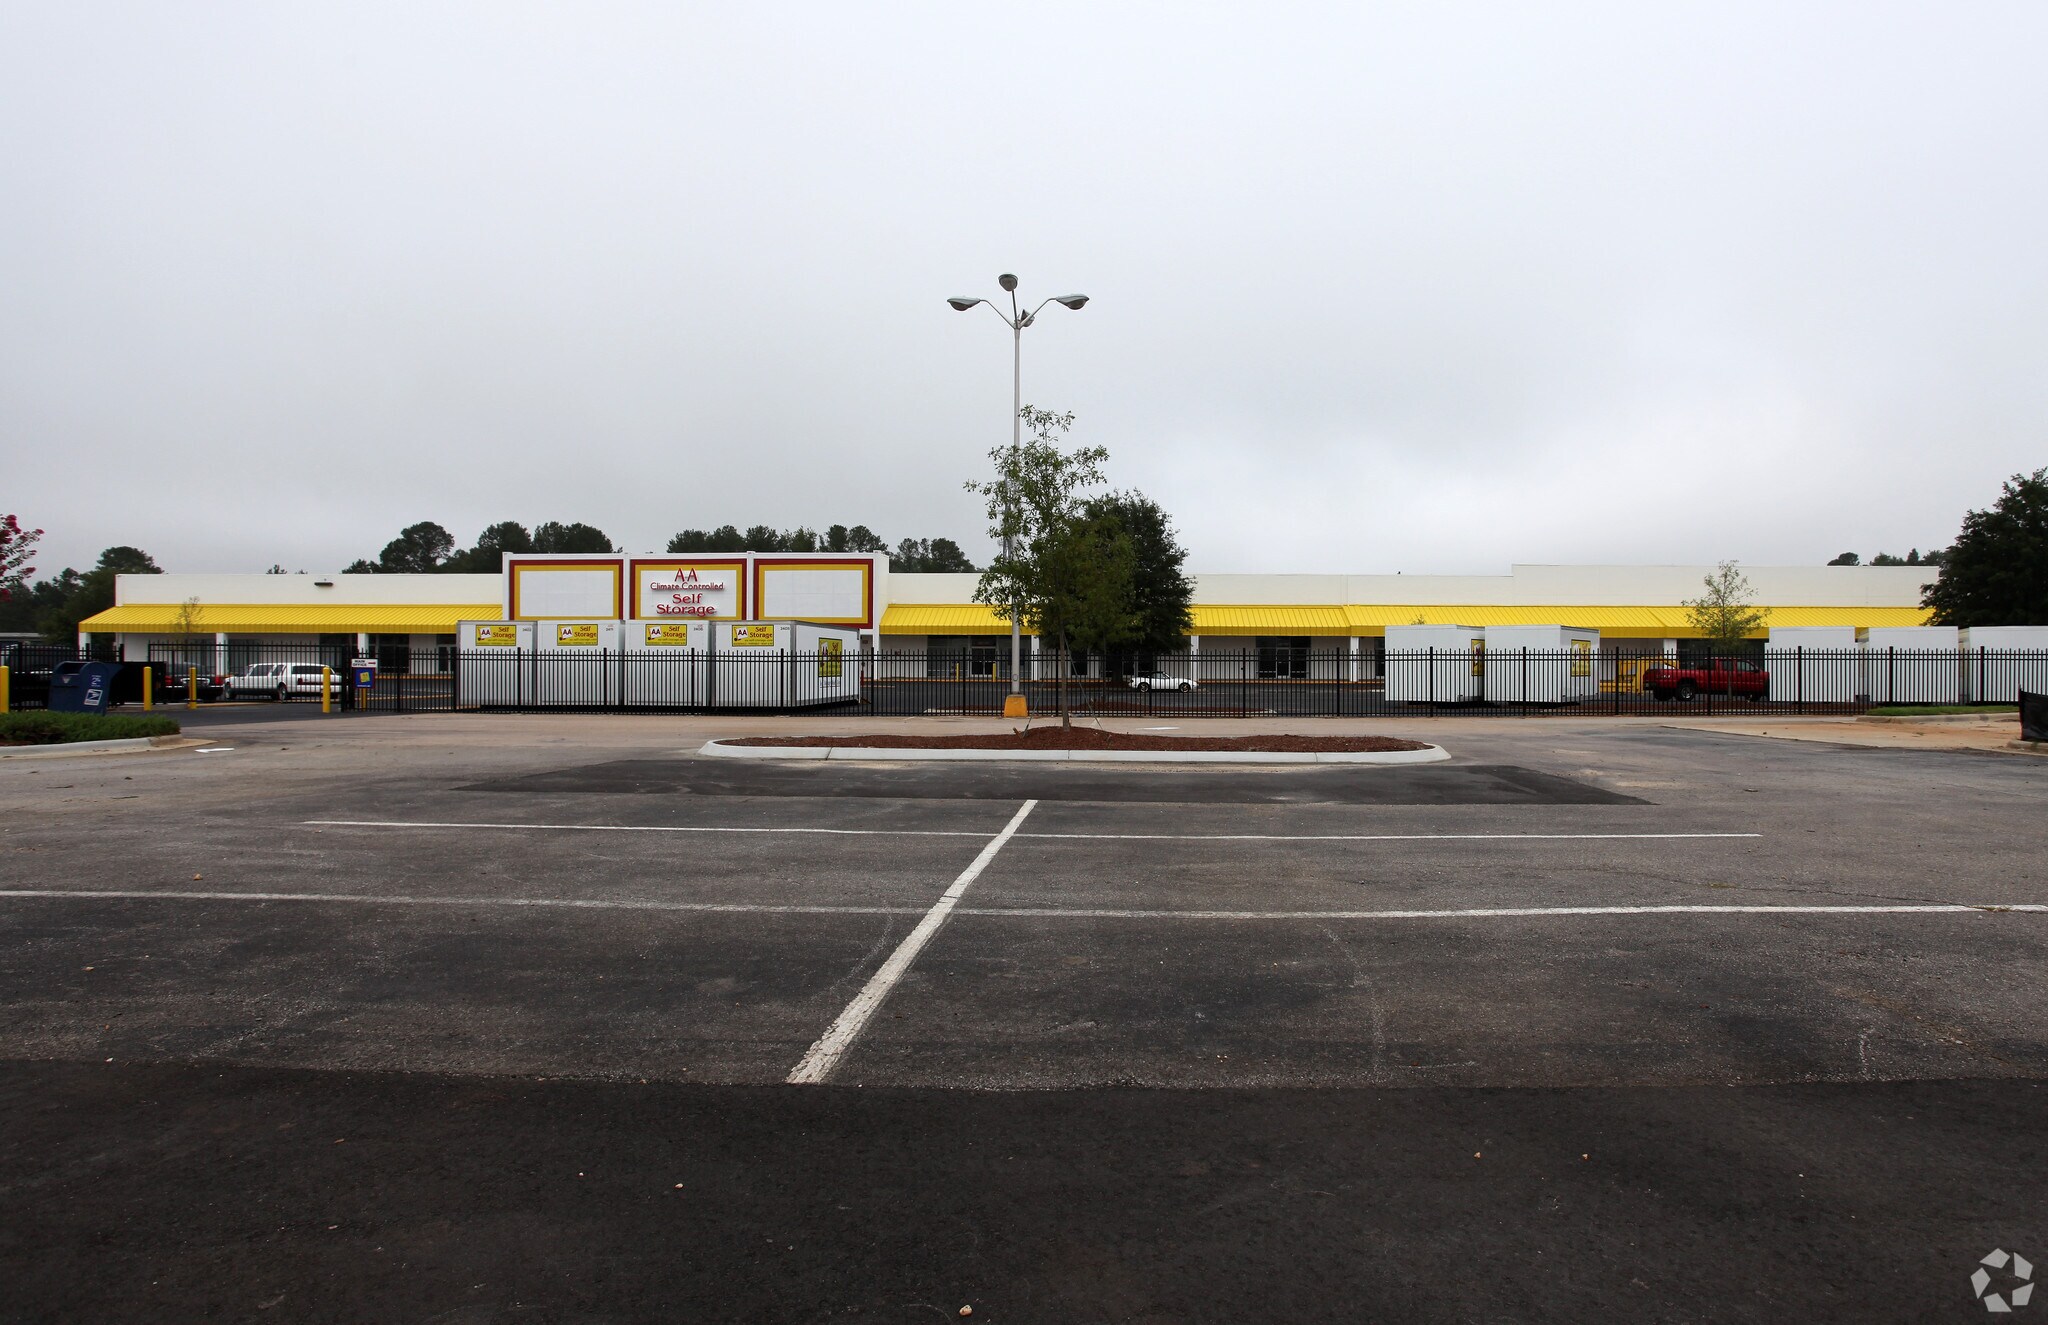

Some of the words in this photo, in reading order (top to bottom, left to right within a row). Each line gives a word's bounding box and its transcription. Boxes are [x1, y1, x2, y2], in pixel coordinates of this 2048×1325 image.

[674, 567, 698, 582] AA
[650, 582, 680, 591] Climate
[681, 582, 724, 591] Controlled
[672, 593, 703, 604] Self
[656, 604, 716, 617] Storage
